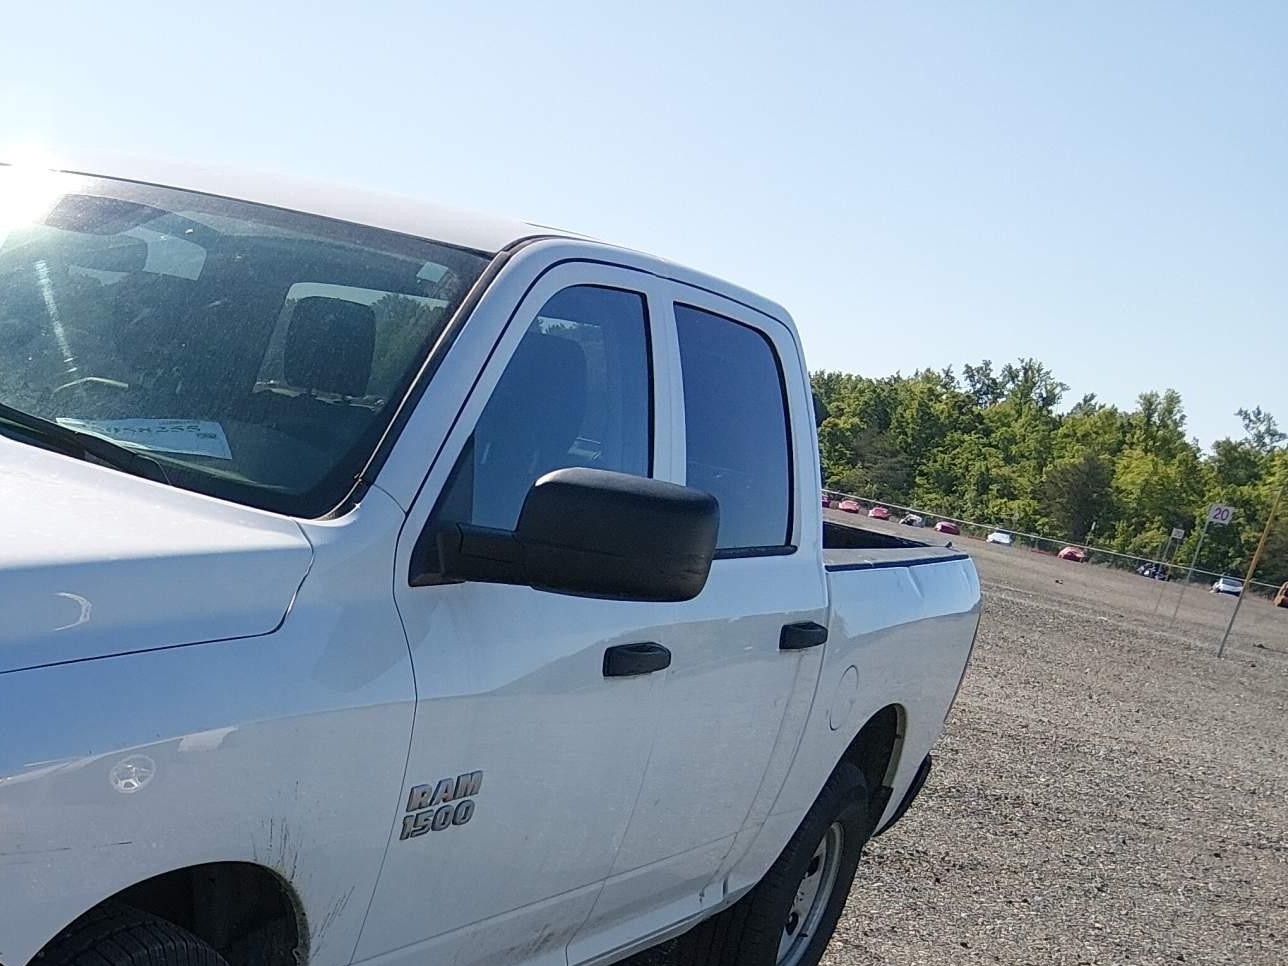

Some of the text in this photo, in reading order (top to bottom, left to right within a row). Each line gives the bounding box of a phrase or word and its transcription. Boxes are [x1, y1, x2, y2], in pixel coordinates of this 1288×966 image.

[1213, 507, 1230, 521] 20
[406, 770, 483, 812] RAM
[400, 800, 475, 840] 1500
